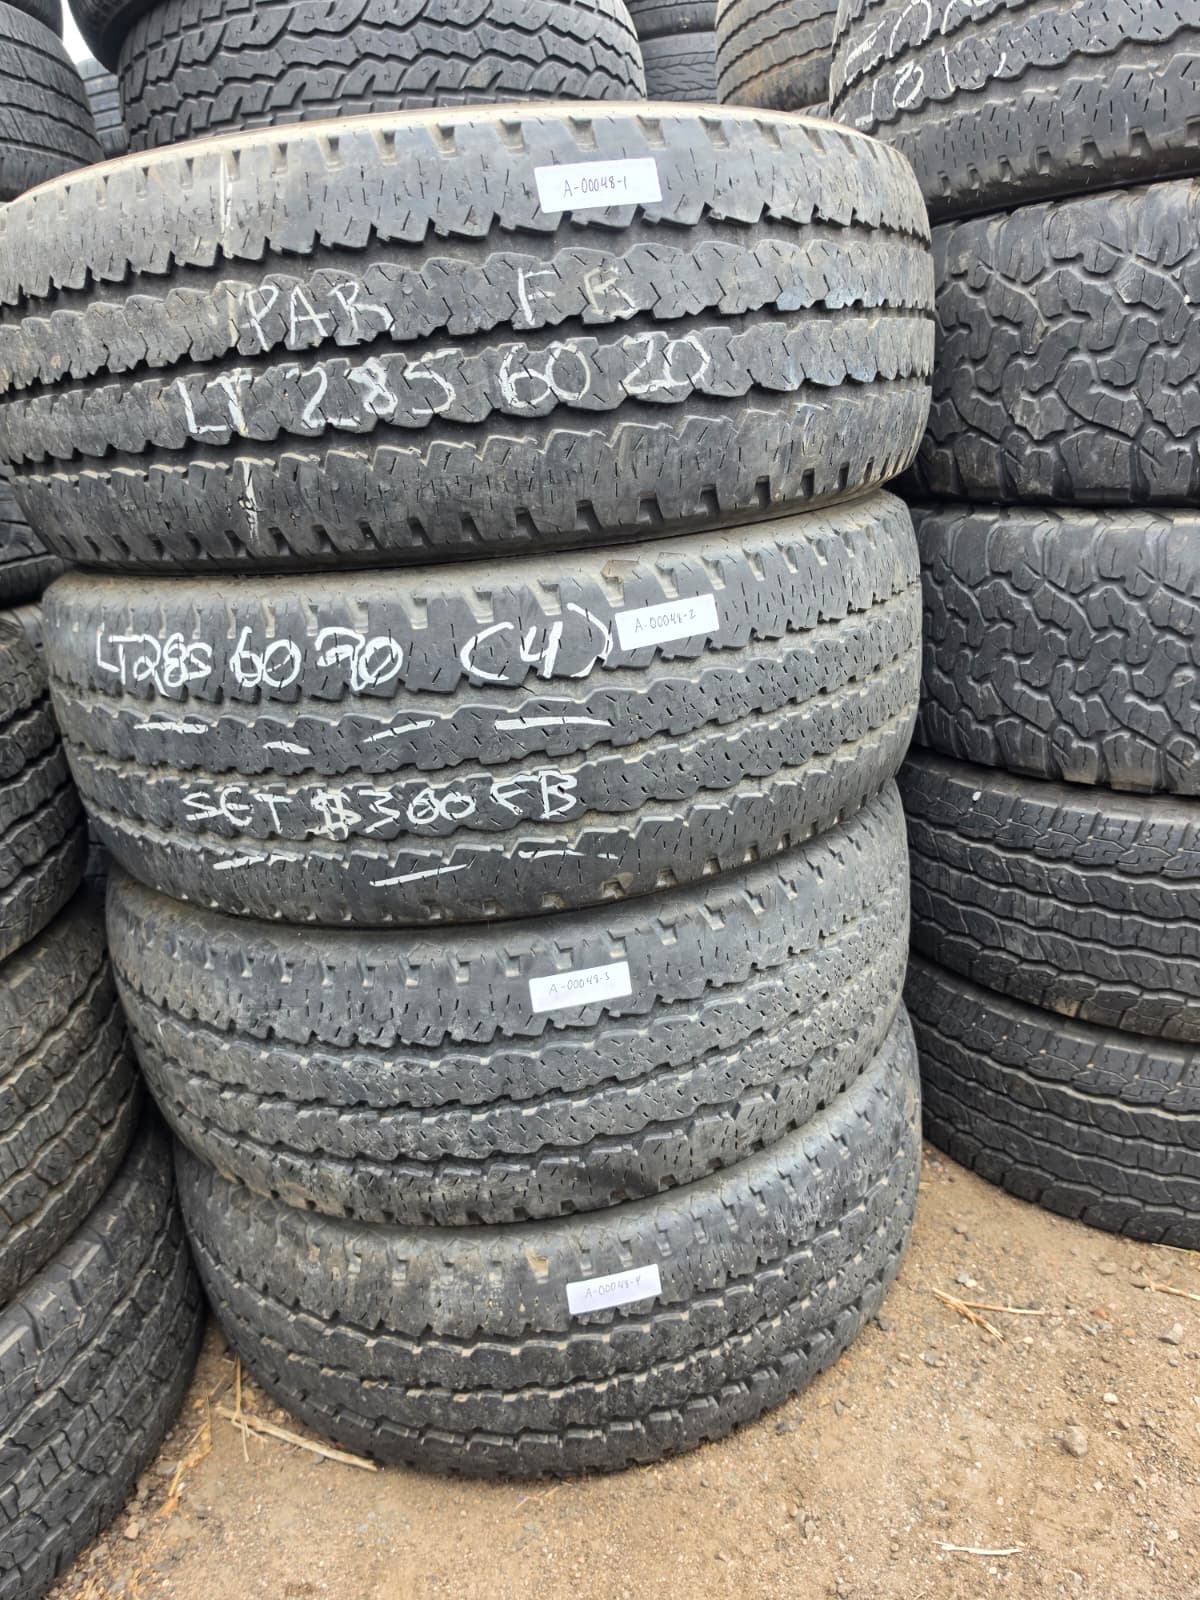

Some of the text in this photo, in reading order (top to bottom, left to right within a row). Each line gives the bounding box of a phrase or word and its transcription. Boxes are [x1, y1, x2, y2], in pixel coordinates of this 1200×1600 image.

[563, 175, 628, 198] A-00048-1
[499, 341, 591, 408] 60
[617, 333, 711, 396] 20
[230, 626, 301, 688] 60
[182, 786, 293, 834] SET
